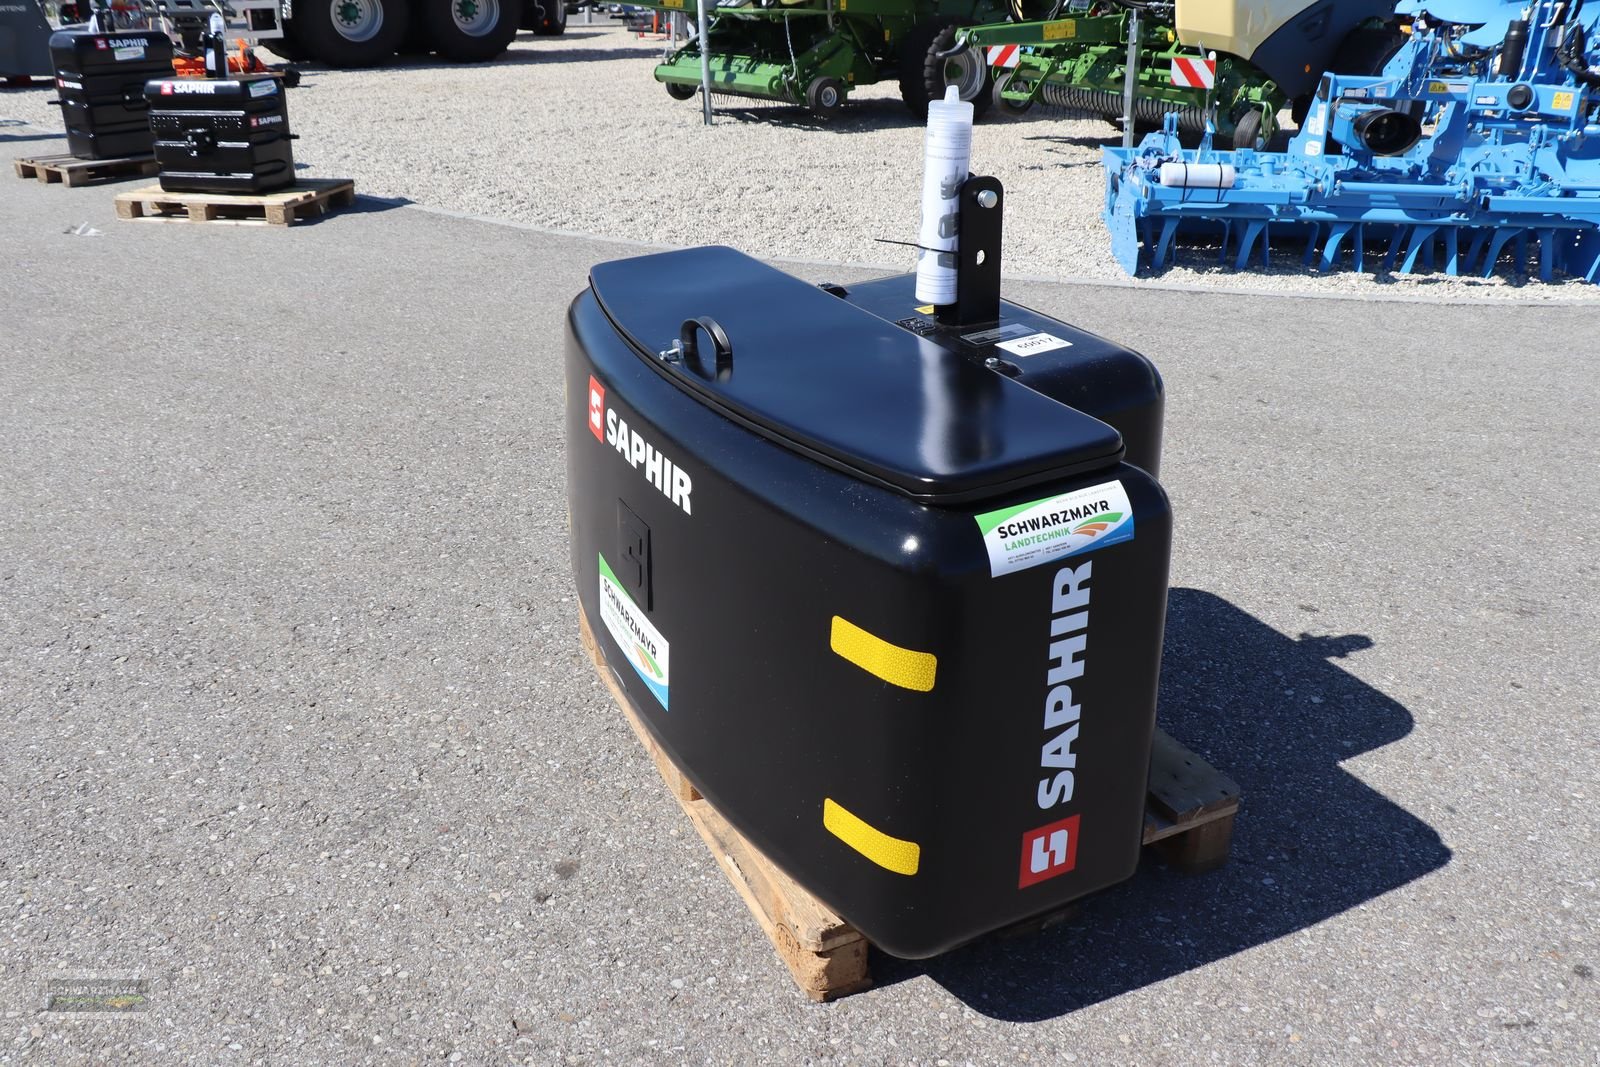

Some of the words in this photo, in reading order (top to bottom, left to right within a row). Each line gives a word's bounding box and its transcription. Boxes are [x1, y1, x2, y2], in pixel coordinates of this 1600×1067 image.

[109, 38, 148, 48] SAPHIR
[173, 82, 215, 94] SAPHIR
[258, 115, 282, 125] SAPHIR
[606, 408, 692, 515] SAPHIR
[998, 500, 1110, 539] SCHWARZMAYR
[1005, 527, 1071, 551] LANDTECHNIK
[603, 579, 657, 660] SCHWARZMAYR
[1037, 560, 1093, 810] SAPHIR
